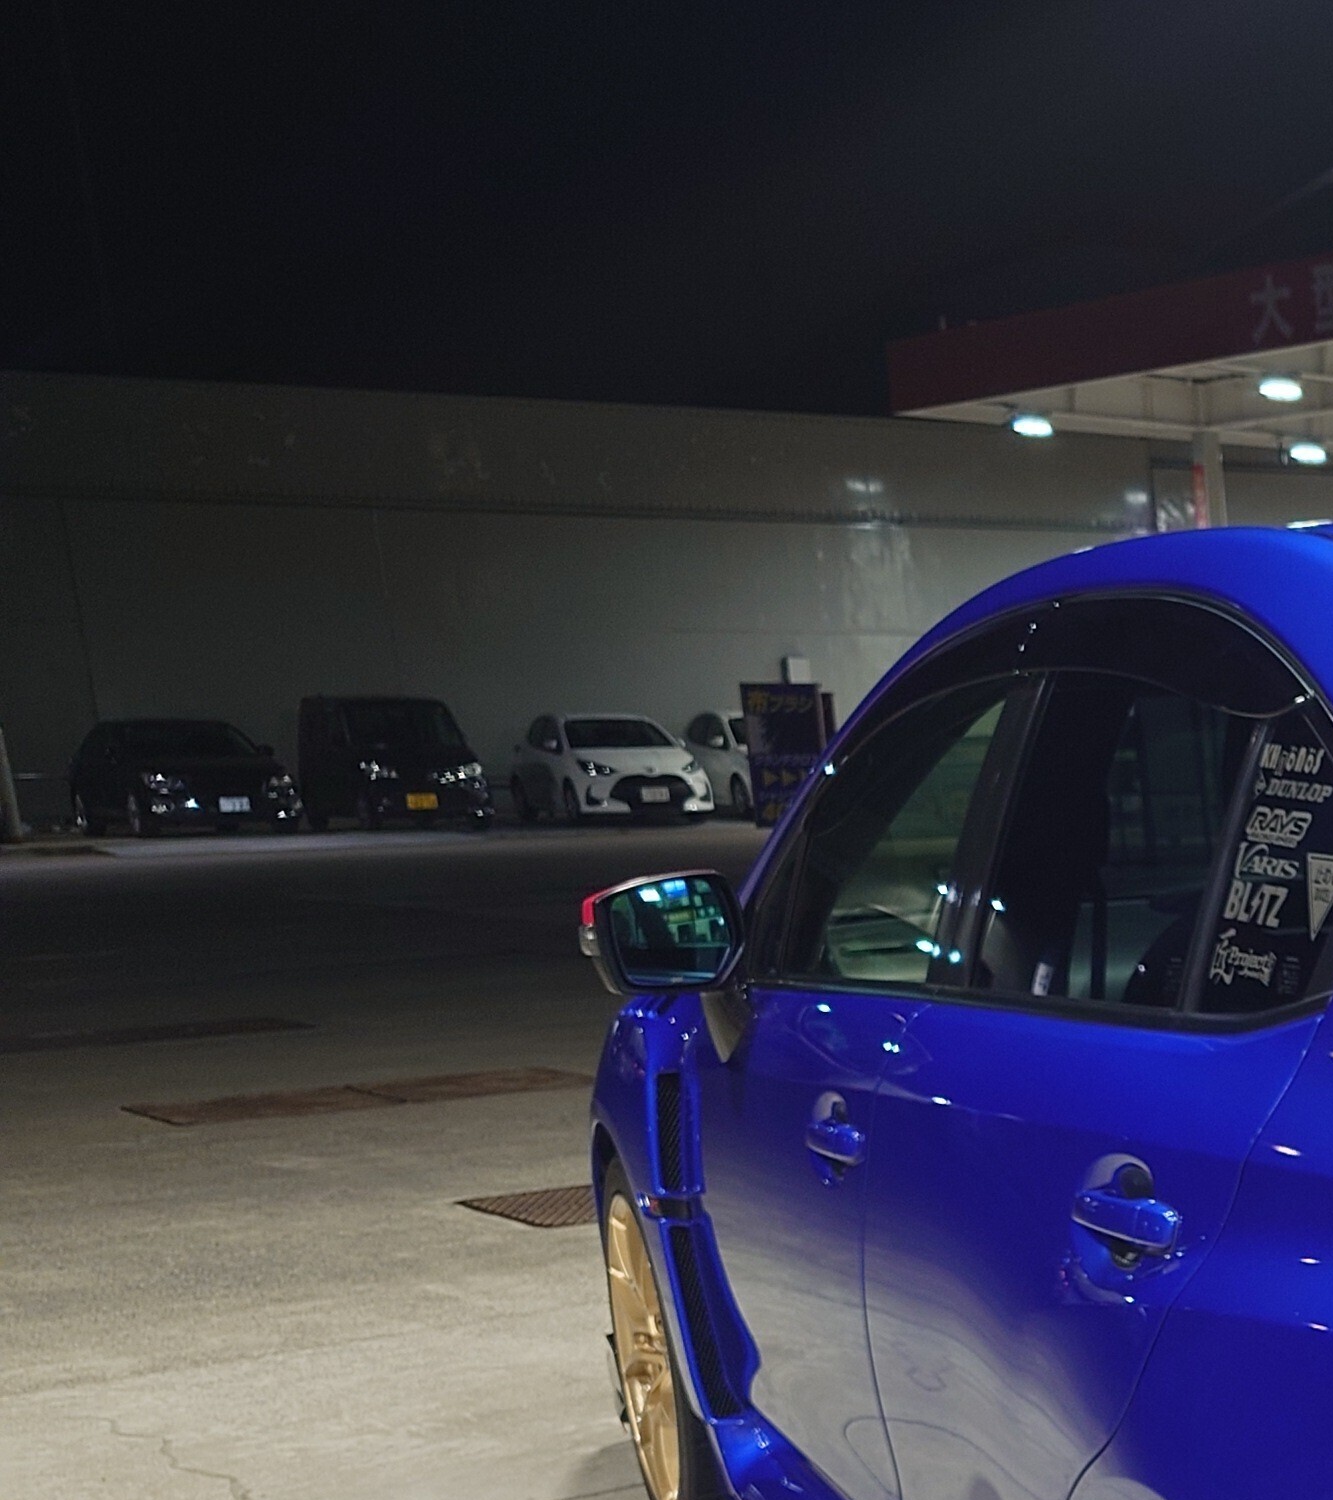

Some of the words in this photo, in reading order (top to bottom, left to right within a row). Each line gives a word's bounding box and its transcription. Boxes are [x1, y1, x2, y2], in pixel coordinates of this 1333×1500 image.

[1266, 778, 1333, 803] DUNLOP
[1248, 807, 1309, 838] RAYS
[1223, 879, 1289, 928] BLITZ
